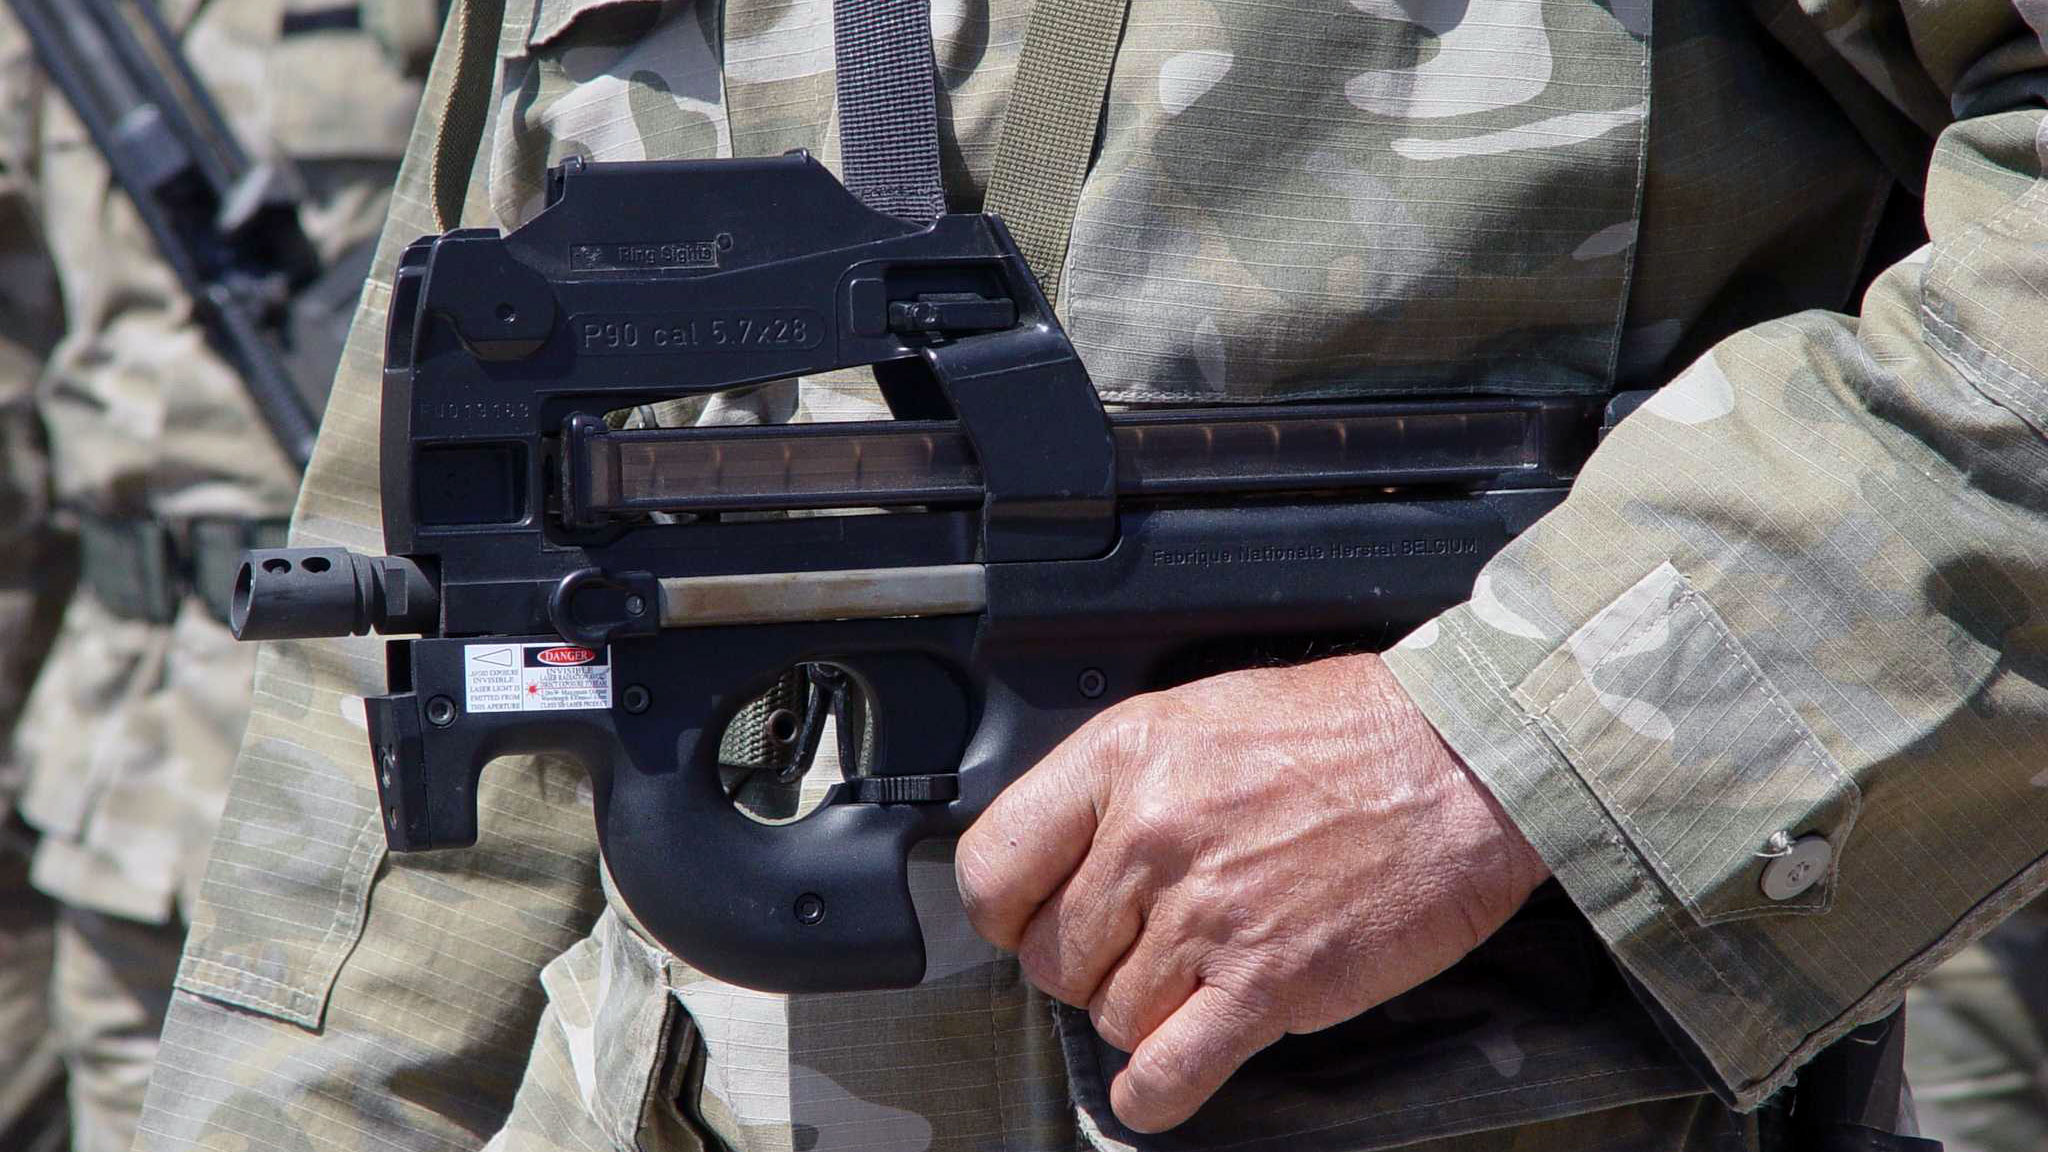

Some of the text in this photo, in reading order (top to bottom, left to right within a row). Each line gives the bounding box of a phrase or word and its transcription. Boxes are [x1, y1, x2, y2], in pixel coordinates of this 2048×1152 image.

[617, 245, 656, 265] Ring
[585, 318, 808, 349] P90 cal 5.7x28
[1152, 538, 1479, 567] Fabrique Nationale Herstal BELGIUM
[545, 650, 588, 662] DANGER
[546, 667, 593, 675] INVISIBLE
[473, 676, 515, 684] INVISIBLE
[470, 694, 501, 702] EMITTED
[471, 703, 486, 711] THIS
